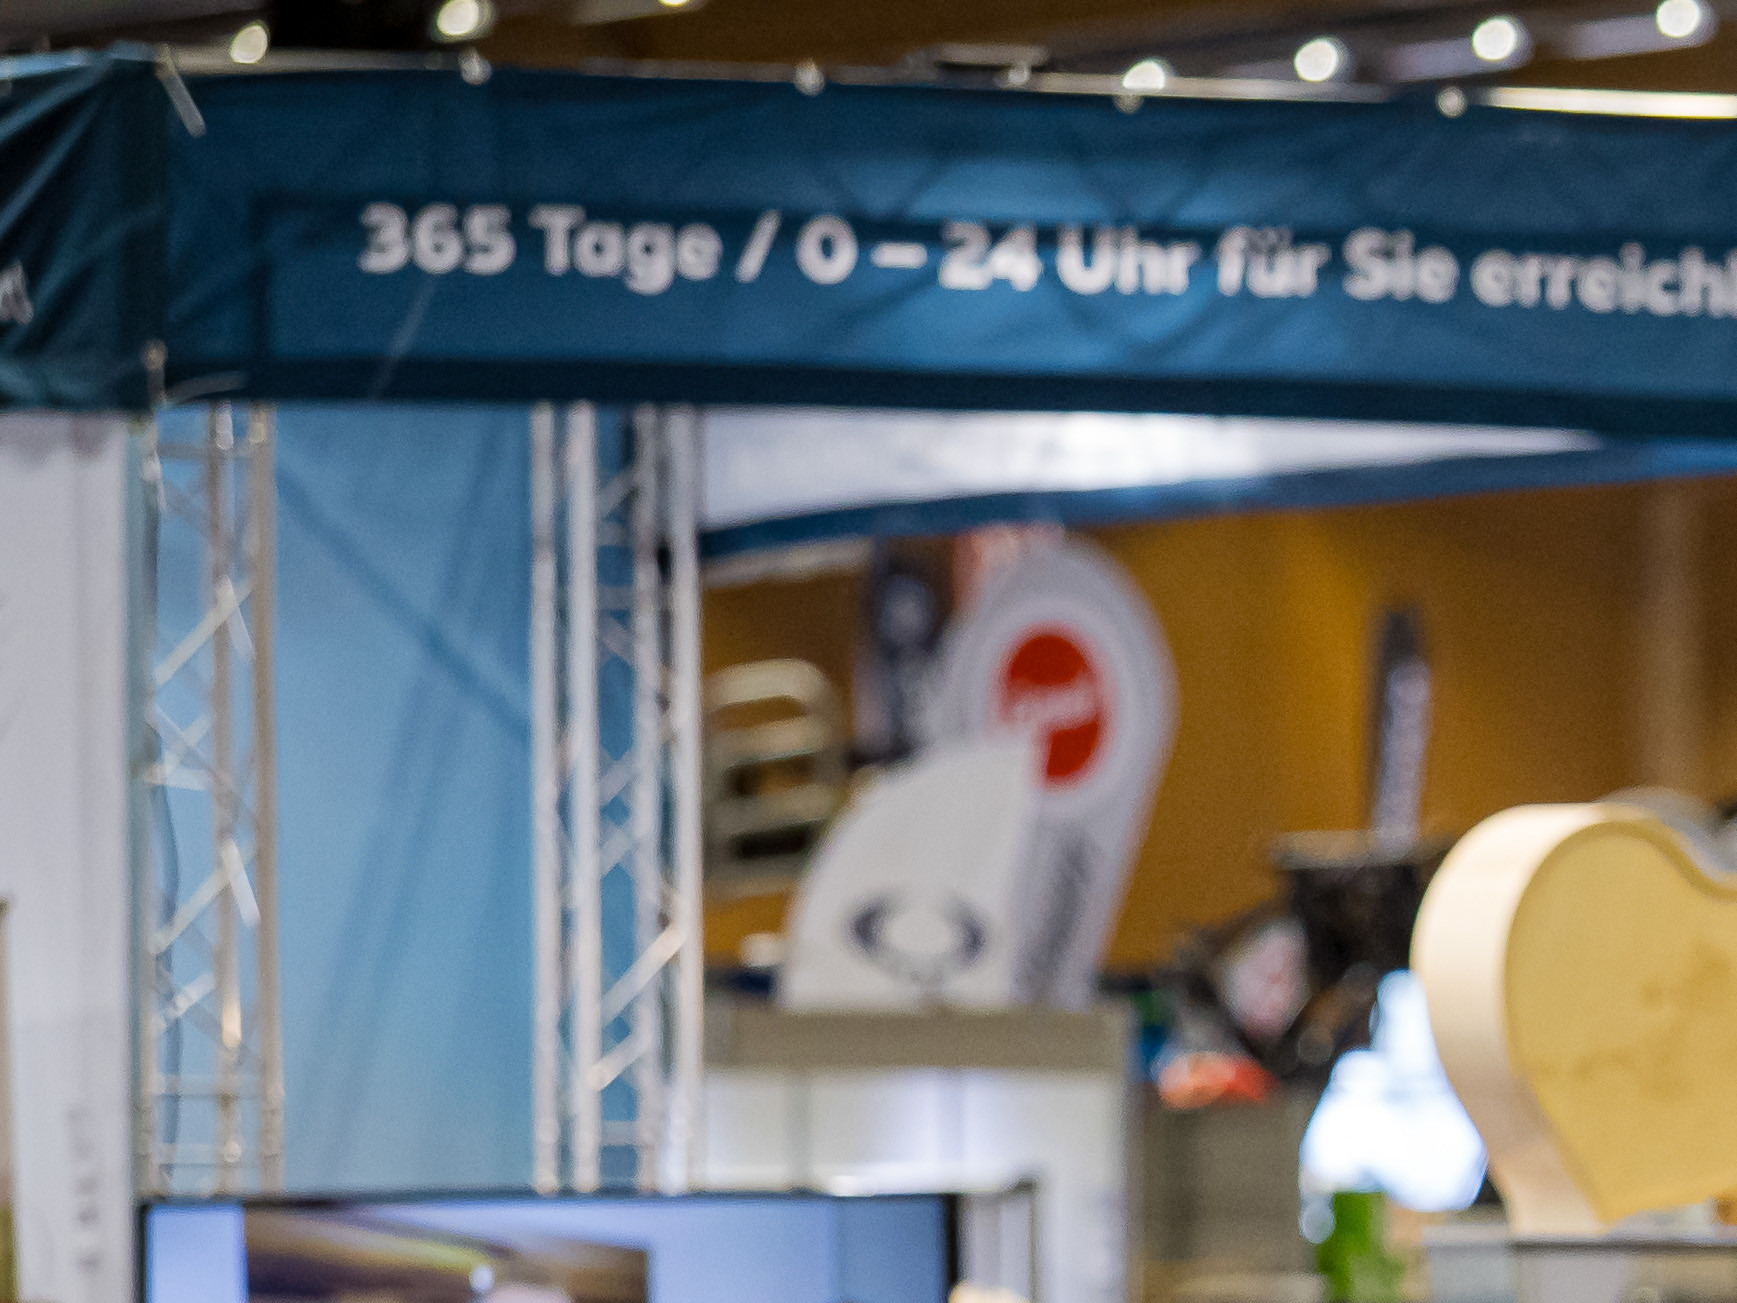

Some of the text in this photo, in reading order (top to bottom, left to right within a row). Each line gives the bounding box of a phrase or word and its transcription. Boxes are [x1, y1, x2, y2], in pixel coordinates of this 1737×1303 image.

[358, 203, 516, 275] 365
[529, 204, 723, 295] Tage
[739, 215, 778, 284] /
[938, 222, 1038, 291] 24
[1055, 230, 1197, 297] Uhr
[1216, 226, 1326, 298] für
[1345, 230, 1459, 304] Sie
